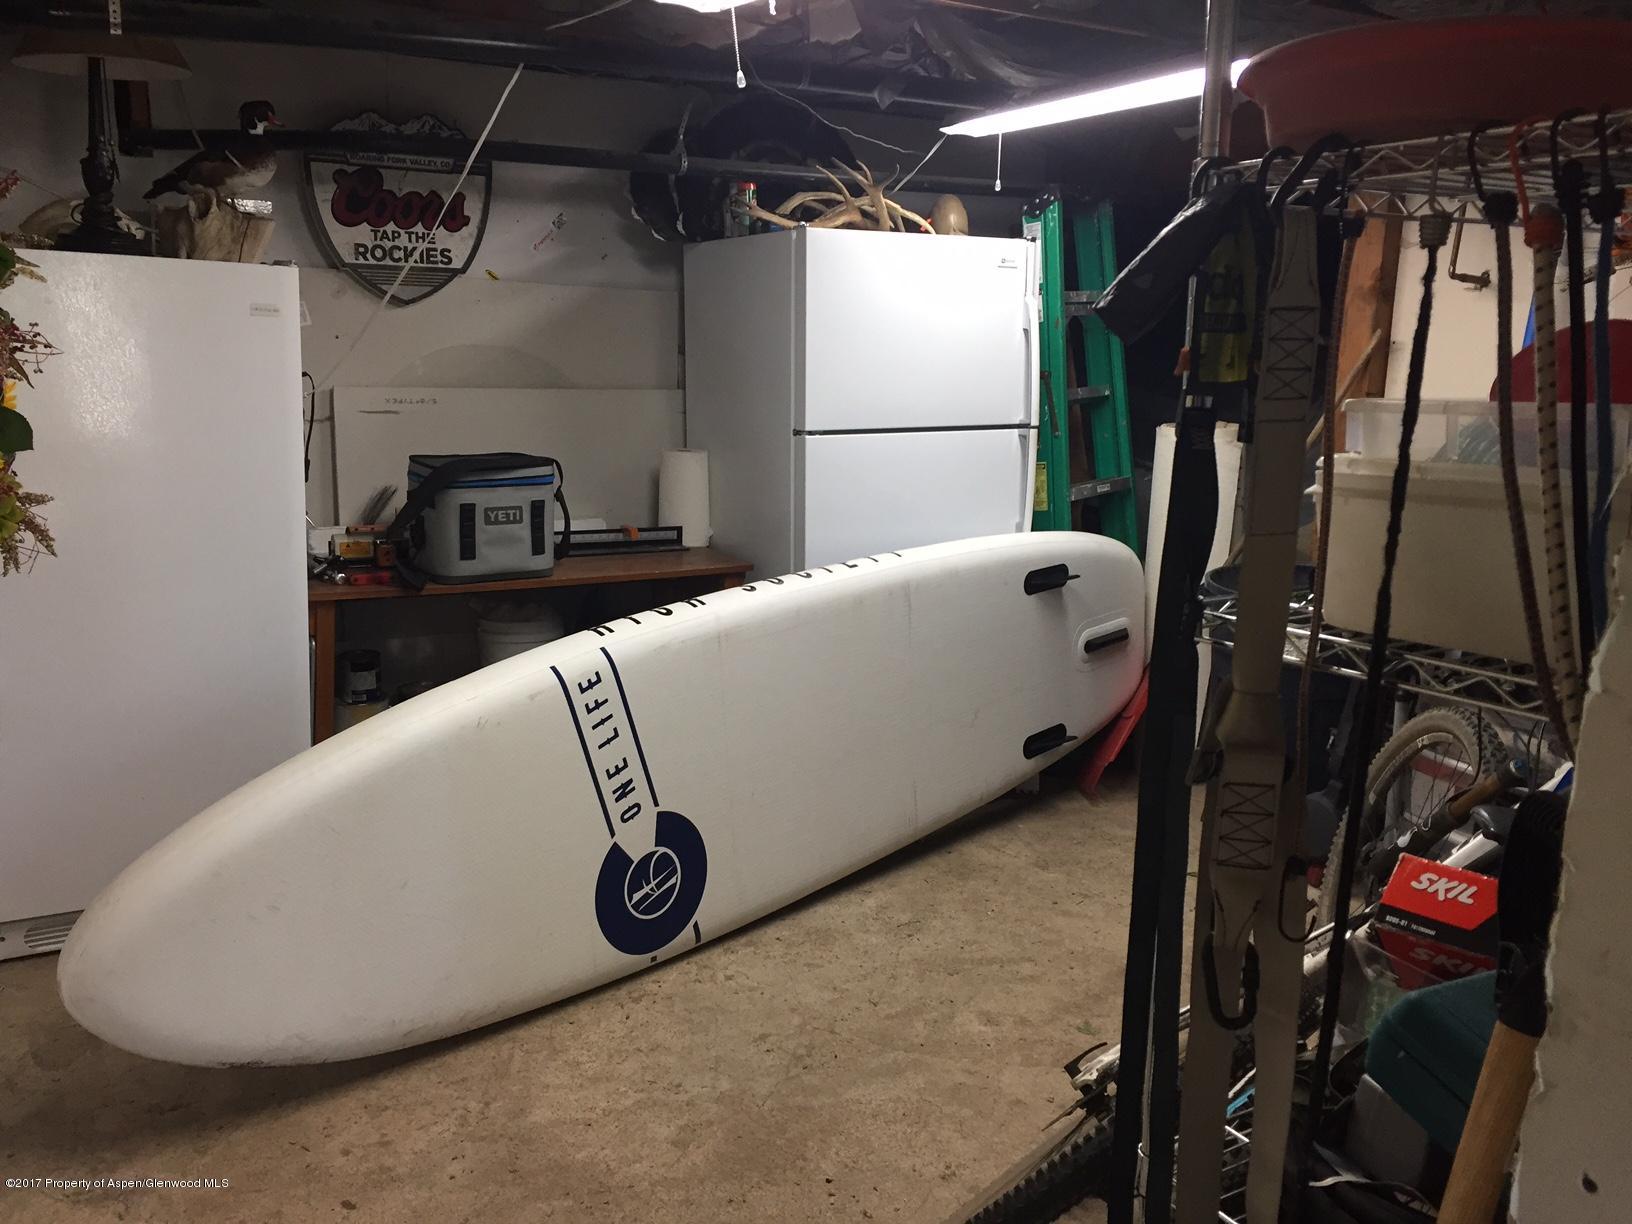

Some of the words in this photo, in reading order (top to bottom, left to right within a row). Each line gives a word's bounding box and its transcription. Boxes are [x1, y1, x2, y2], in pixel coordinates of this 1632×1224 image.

[331, 166, 471, 233] Coors
[370, 228, 401, 242] TAP
[405, 230, 436, 244] THE
[353, 242, 453, 266] ROCKIES
[487, 509, 520, 521] YETI
[577, 671, 620, 750] LIFE
[605, 757, 642, 824] ONE
[1410, 872, 1478, 905] SKIL
